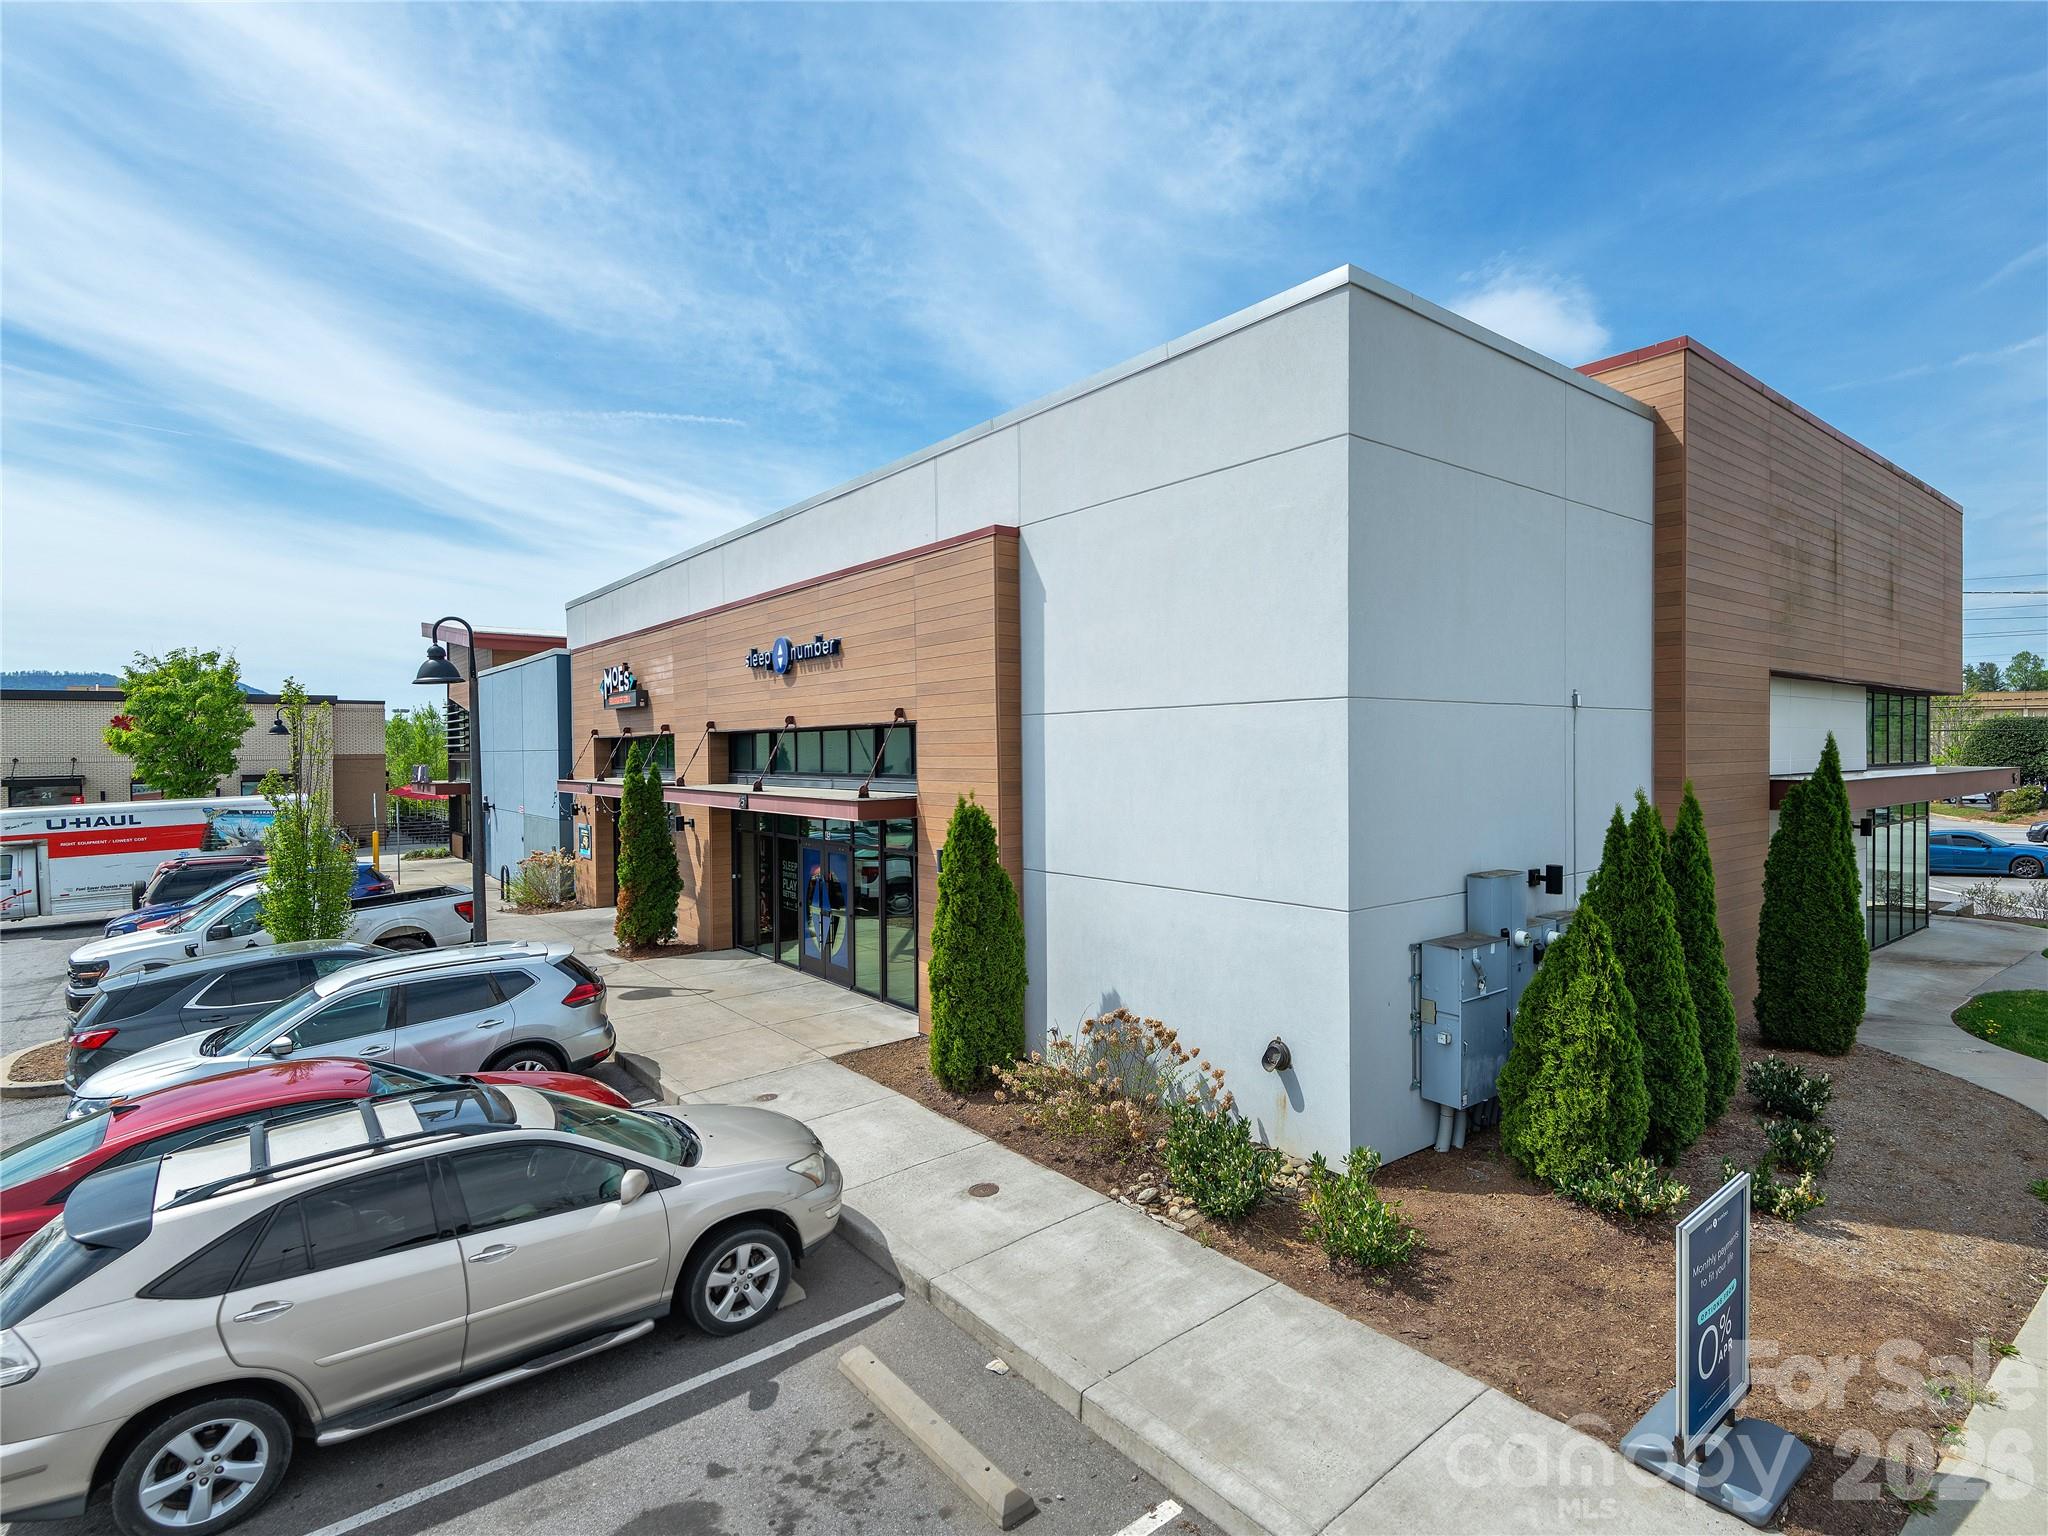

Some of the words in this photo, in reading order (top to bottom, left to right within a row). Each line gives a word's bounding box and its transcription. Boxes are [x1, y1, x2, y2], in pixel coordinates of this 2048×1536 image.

[745, 648, 772, 670] sleep
[790, 633, 840, 661] number
[41, 791, 52, 799] 21
[46, 814, 142, 830] U-HAUL
[782, 860, 798, 871] SLEEP
[782, 878, 798, 891] PLAY
[1693, 1253, 1717, 1278] Monthly
[1717, 1230, 1739, 1261] payments
[1701, 1278, 1708, 1289] to
[1715, 1260, 1727, 1279] your
[1700, 1297, 1723, 1322] OPTIONS
[1723, 1284, 1736, 1301] FROM
[1718, 1337, 1733, 1364] APR
